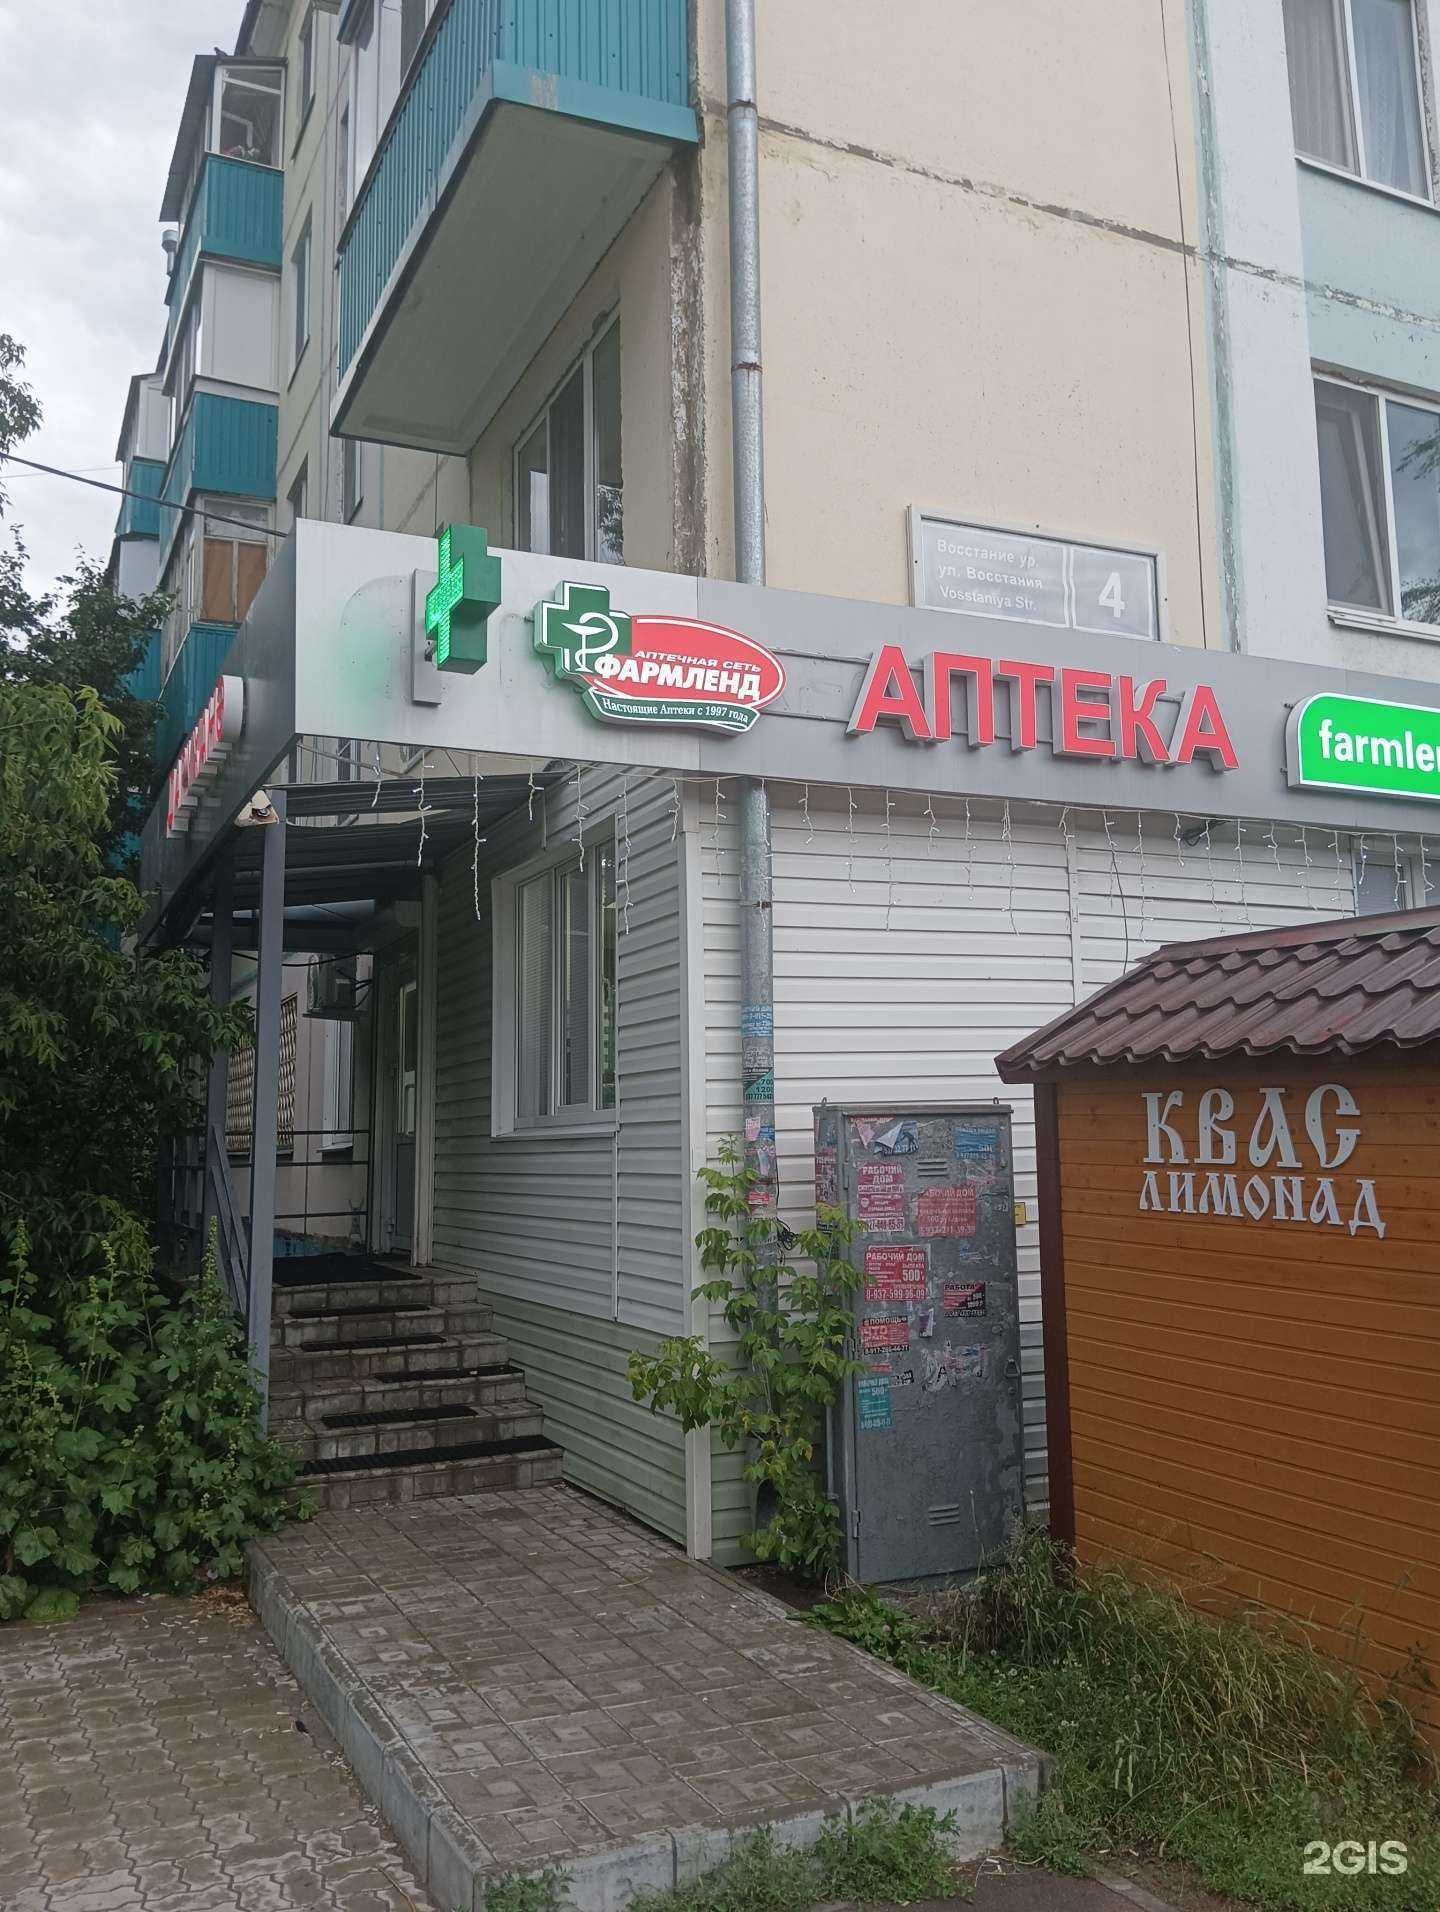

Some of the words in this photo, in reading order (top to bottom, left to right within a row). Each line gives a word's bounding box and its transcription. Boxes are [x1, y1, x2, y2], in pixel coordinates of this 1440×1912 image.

[937, 539, 1015, 563] Восстание
[1020, 554, 1039, 569] ур.
[938, 564, 961, 578] ул.
[966, 567, 1043, 589] Восстания
[940, 585, 1012, 609] Vosstaniya
[1015, 595, 1037, 611] Str.
[1098, 571, 1126, 618] 4
[634, 650, 718, 667] АПТЕЧНАЯ
[722, 661, 762, 673] СЕТЬ
[594, 654, 762, 701] ФАРМЛЕНД
[602, 698, 658, 715] Настоящие
[660, 704, 695, 716] Аптеки
[705, 705, 728, 717] 1997
[728, 709, 749, 723] года
[850, 643, 1240, 770] АПТЕКА
[1141, 1083, 1361, 1169] КВАС
[1138, 1170, 1387, 1239] ЛИМОНАД
[907, 1252, 925, 1262] ДОМ
